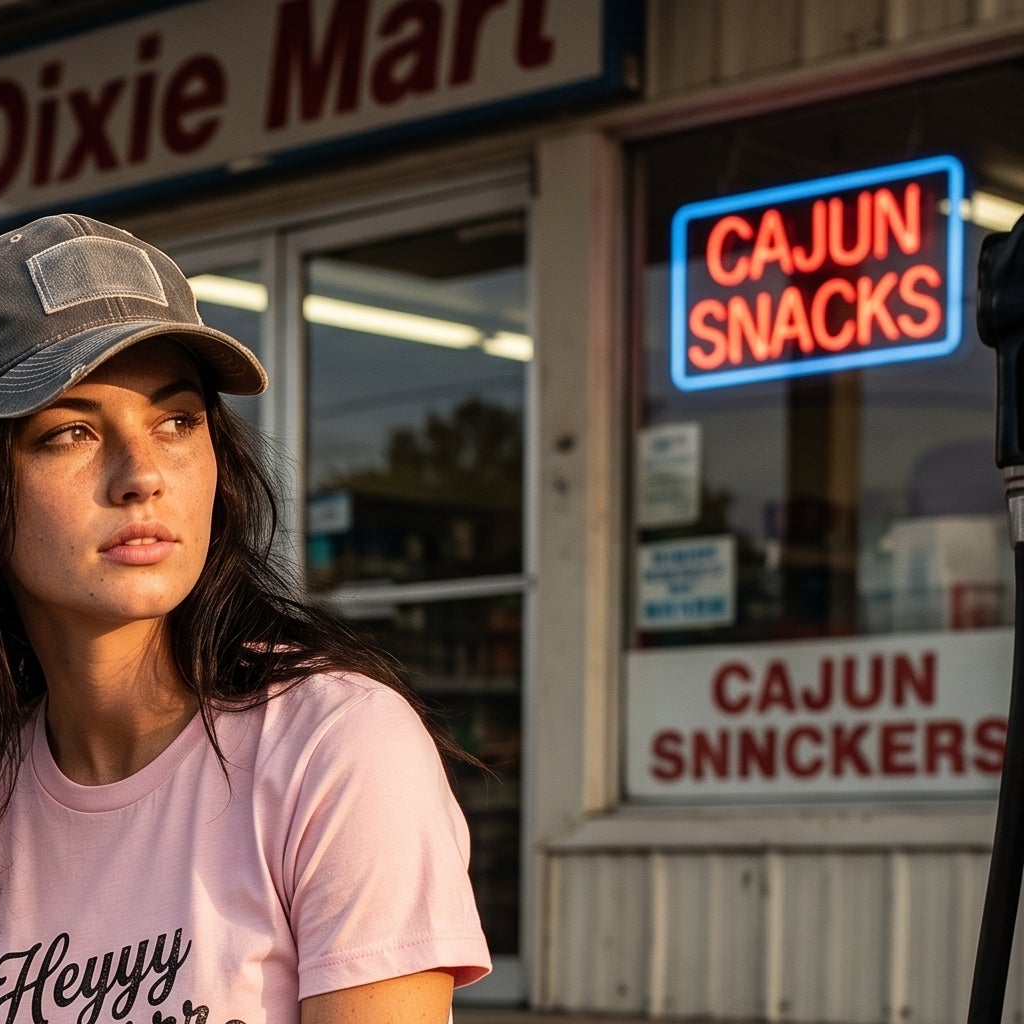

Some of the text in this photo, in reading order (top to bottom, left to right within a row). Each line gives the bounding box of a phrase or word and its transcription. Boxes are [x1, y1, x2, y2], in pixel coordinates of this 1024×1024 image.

[264, 0, 555, 133] Mart
[706, 182, 921, 287] CAJUN
[688, 264, 943, 371] SNACKS
[711, 649, 937, 716] CAJUN
[649, 713, 1010, 785] SNNCKERS
